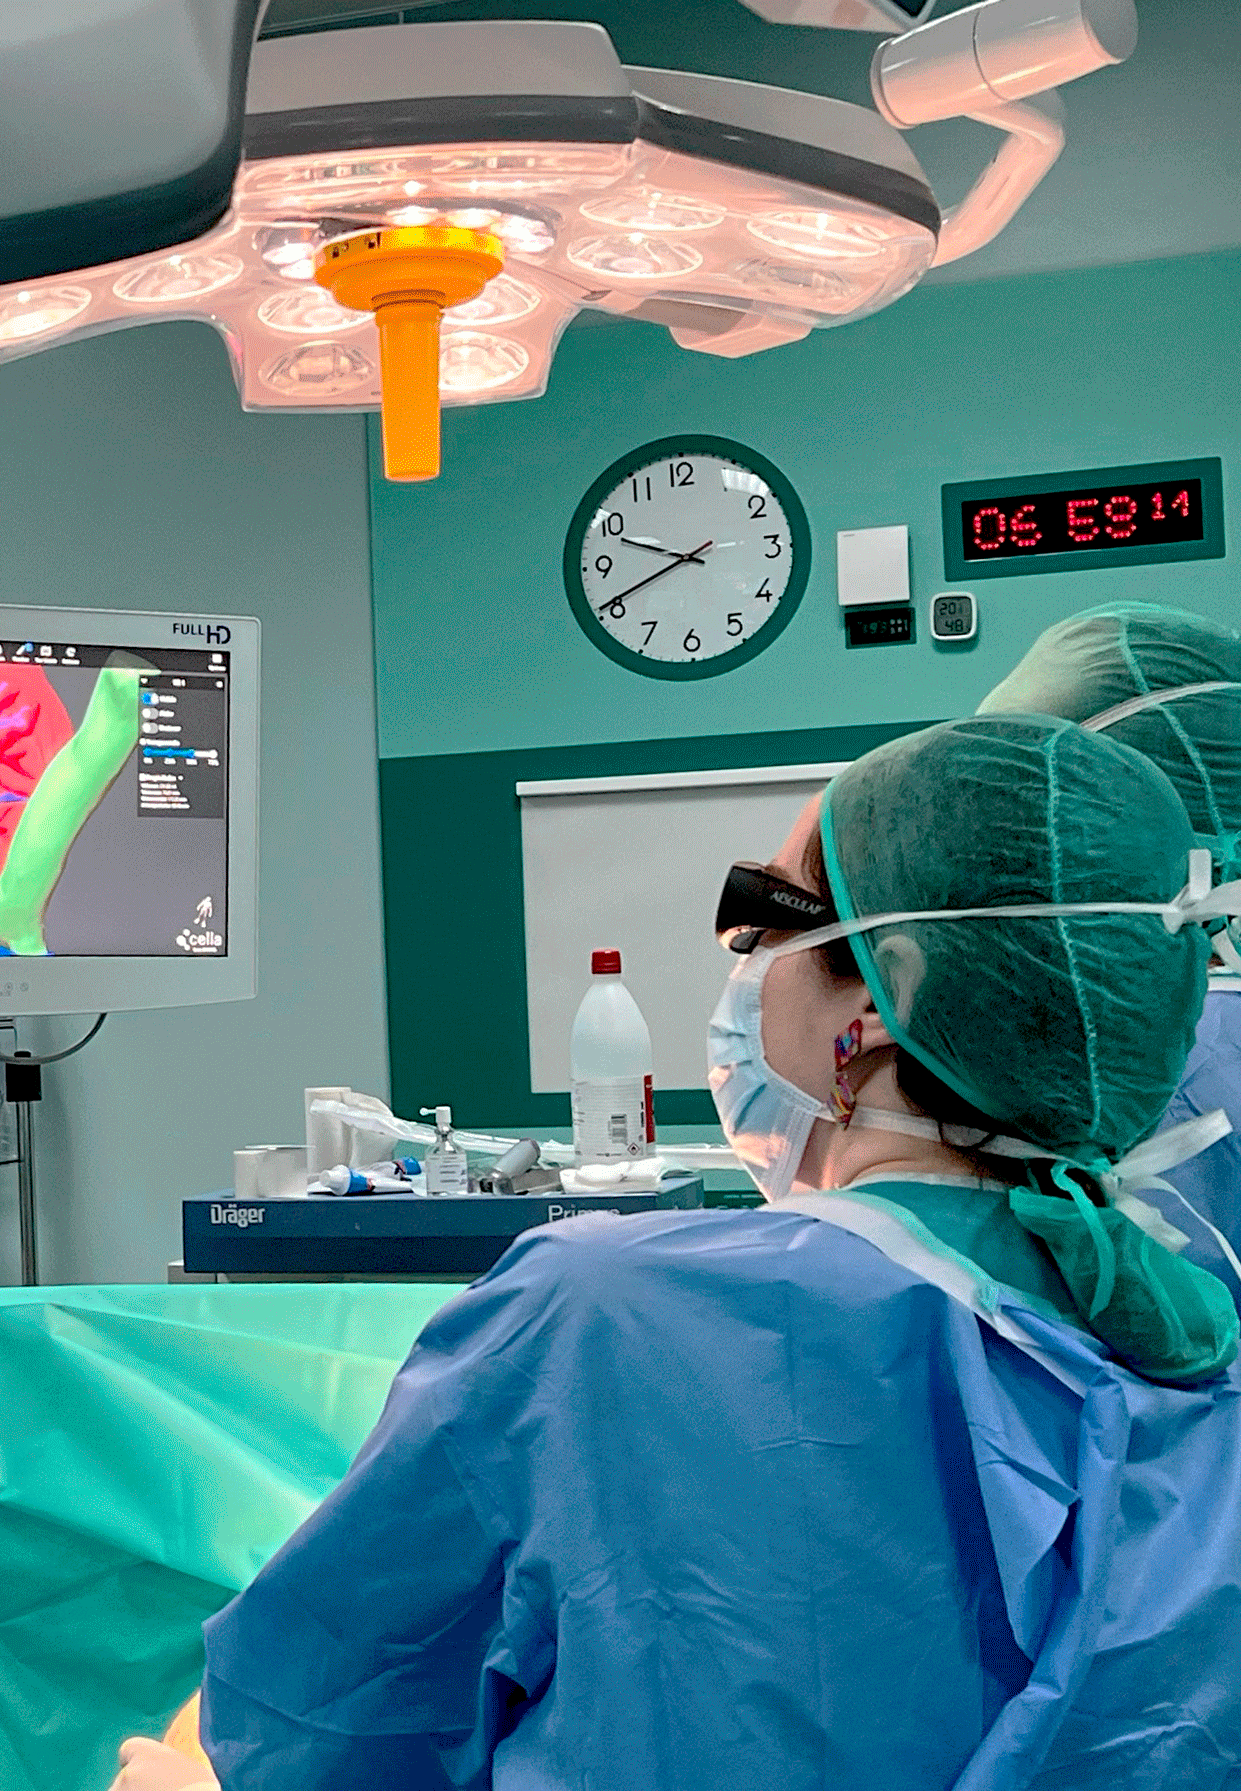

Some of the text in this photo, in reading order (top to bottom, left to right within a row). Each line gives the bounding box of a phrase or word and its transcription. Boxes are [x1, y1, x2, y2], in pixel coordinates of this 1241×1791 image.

[670, 461, 695, 487] 12
[632, 477, 652, 502] 11
[747, 494, 767, 519] 2
[602, 512, 624, 537] 10
[972, 504, 1043, 550] 06
[763, 534, 782, 559] 3
[595, 555, 613, 579] 9
[754, 578, 773, 602] 4
[609, 595, 626, 619] 8
[641, 621, 658, 646] 7
[726, 612, 743, 637] 5
[683, 628, 701, 652] 6
[189, 931, 222, 947] cella
[211, 1203, 266, 1228] Dräger
